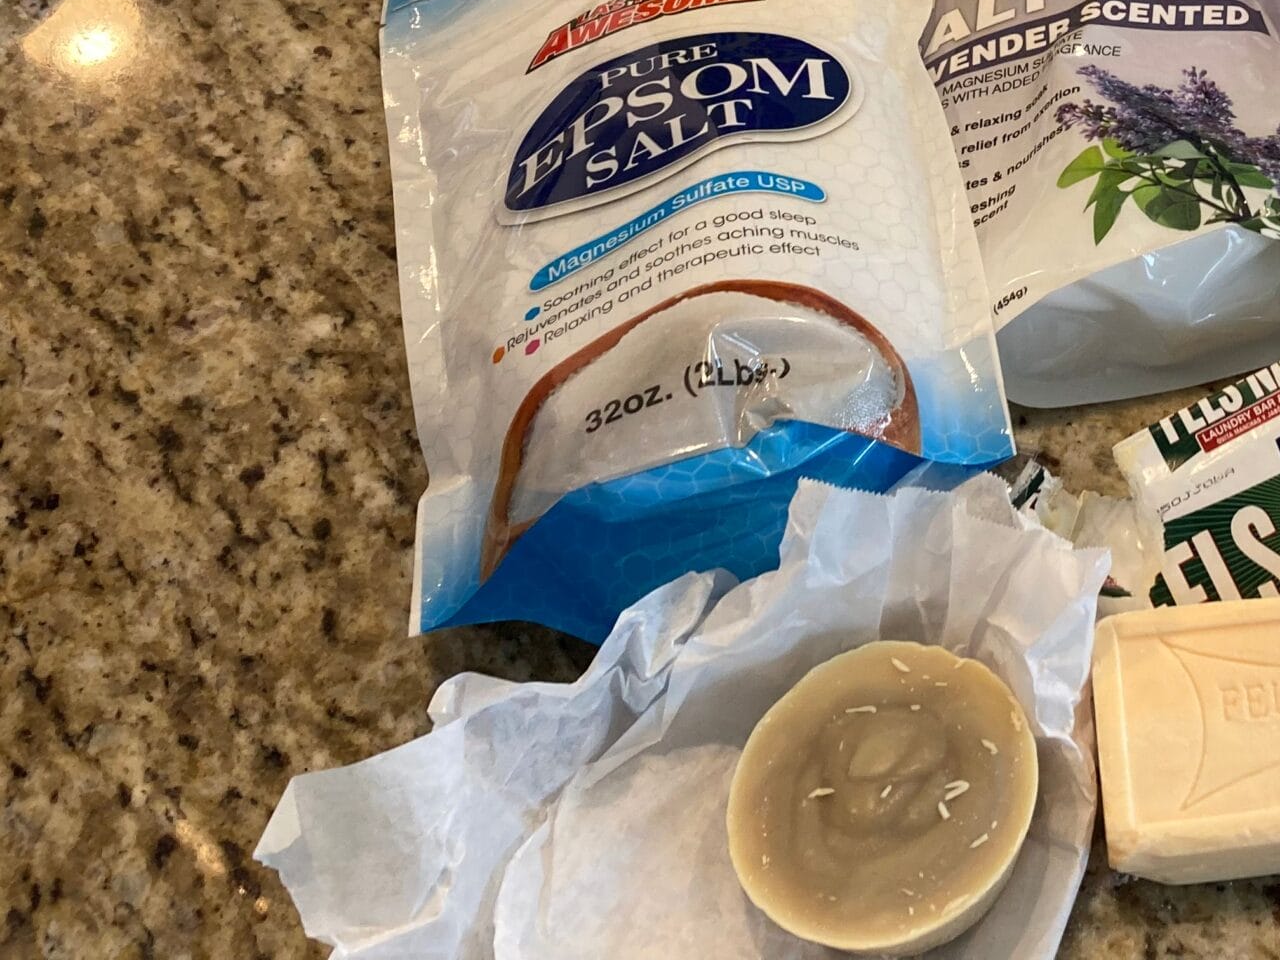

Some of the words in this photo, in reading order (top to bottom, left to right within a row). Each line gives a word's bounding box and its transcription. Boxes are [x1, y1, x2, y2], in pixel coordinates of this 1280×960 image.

[1080, 0, 1251, 27] SCENTED
[600, 42, 718, 90] PURE
[515, 56, 835, 202] EPSOM
[585, 98, 753, 189] SALT
[543, 267, 616, 313] Soothing
[618, 237, 665, 271] effect
[667, 224, 691, 247] for
[694, 220, 707, 231] a
[713, 207, 765, 229] good
[769, 209, 818, 227] sleep
[547, 206, 668, 282] Magnesium
[671, 175, 750, 211] Sulfate
[757, 173, 806, 195] USP
[584, 384, 674, 435] 32oz.
[1200, 410, 1252, 443] LAUNDRY
[1252, 396, 1277, 418] BAR
